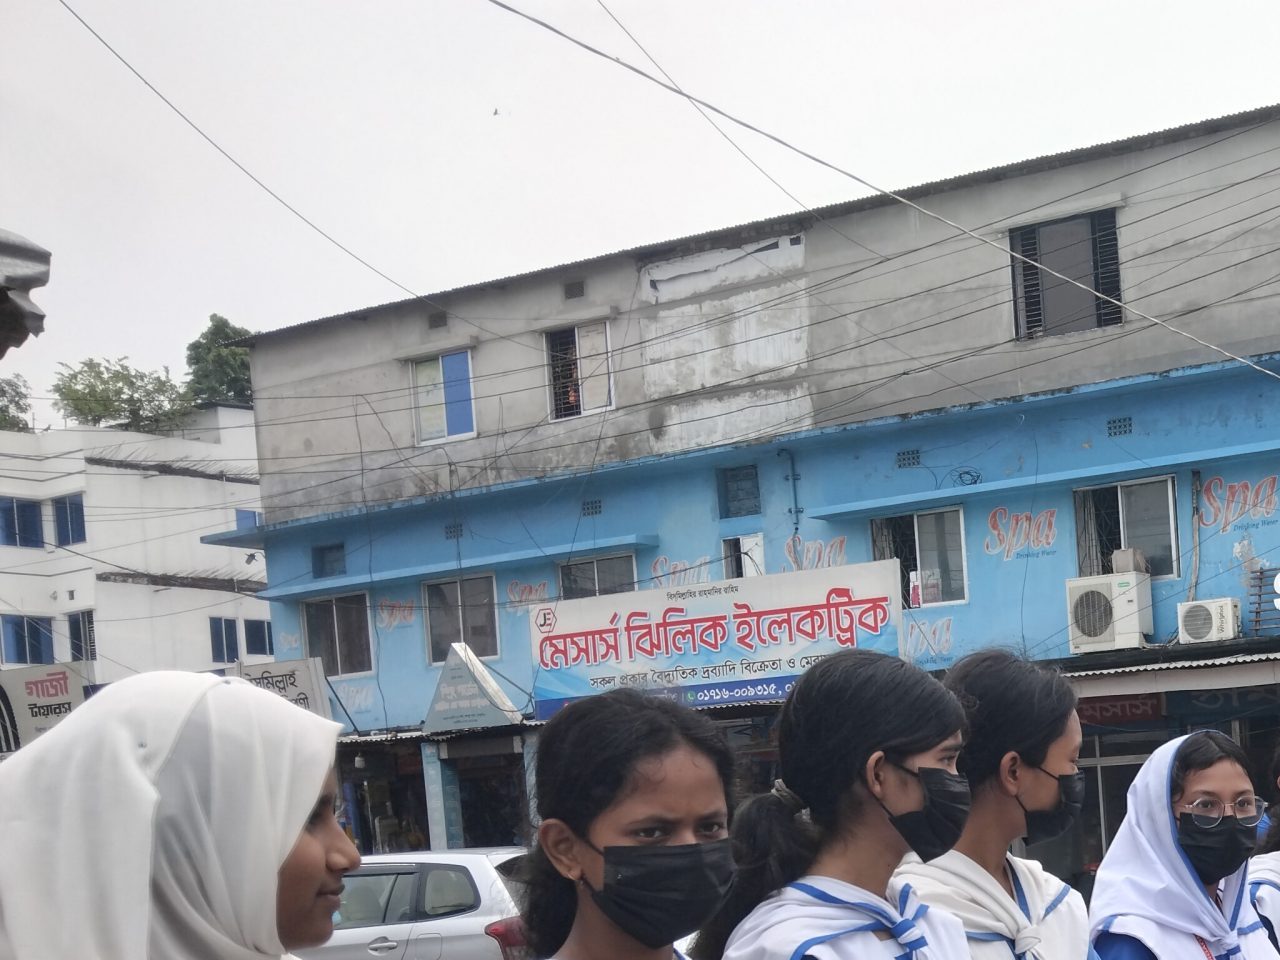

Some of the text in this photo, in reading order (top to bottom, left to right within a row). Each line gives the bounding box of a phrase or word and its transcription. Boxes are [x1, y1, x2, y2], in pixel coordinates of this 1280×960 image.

[1200, 476, 1279, 536] Spa
[984, 507, 1058, 562] Spa
[539, 588, 889, 669] মেসার্স ঝিলিক ইলেকট্রিক
[904, 616, 953, 656] pa
[25, 671, 69, 699] গাজী
[28, 701, 72, 720] টায়ারস
